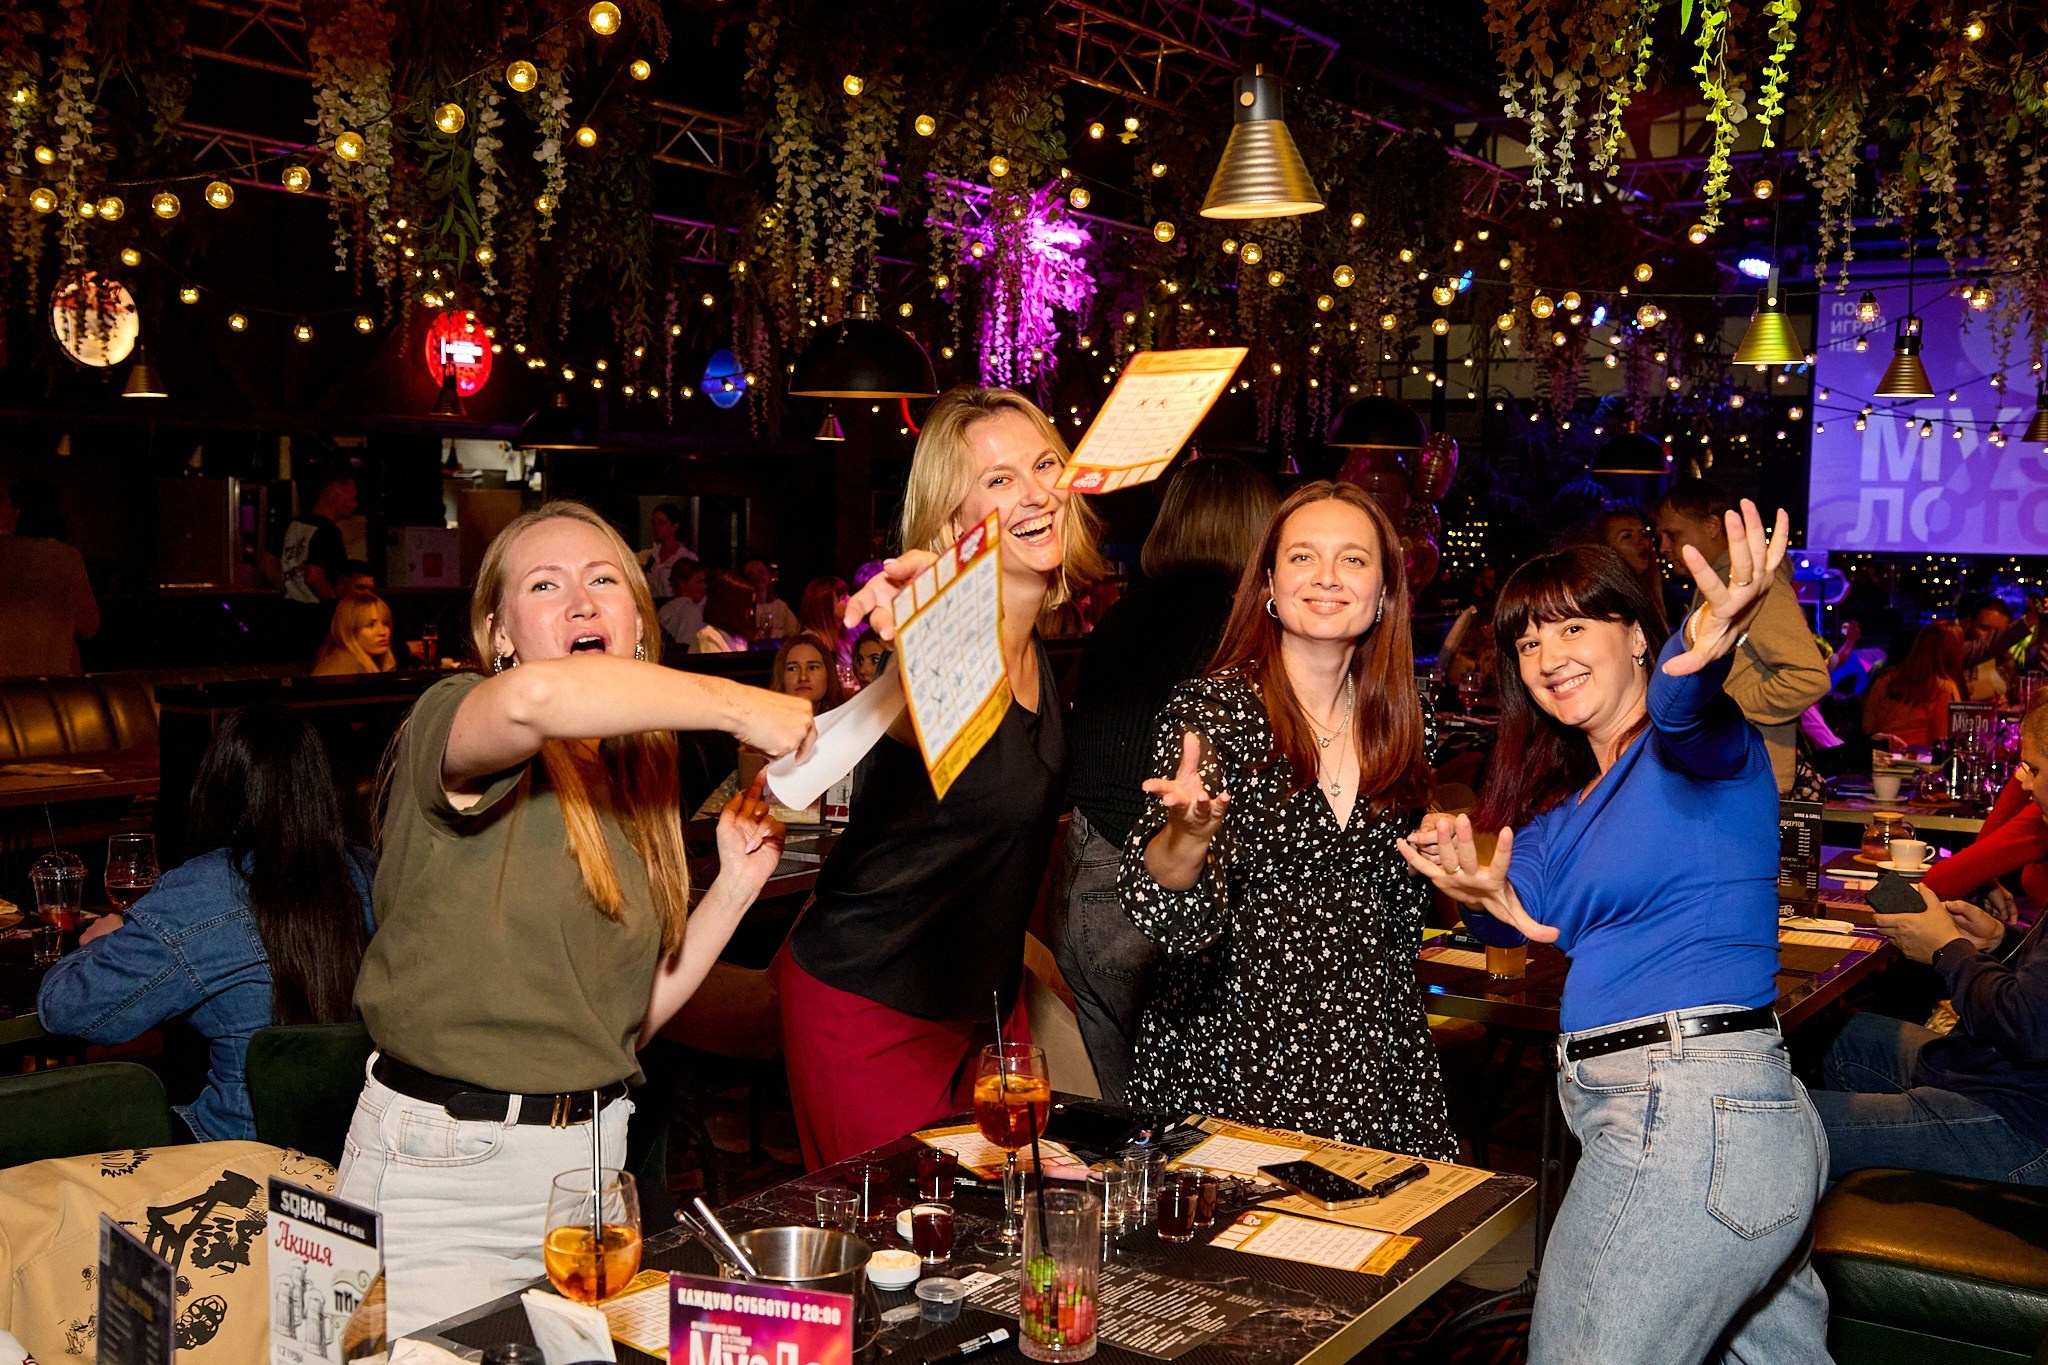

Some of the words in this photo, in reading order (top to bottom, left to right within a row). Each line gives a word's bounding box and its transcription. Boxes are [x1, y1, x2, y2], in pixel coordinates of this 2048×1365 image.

[275, 1221, 333, 1267] Акция
[677, 1287, 733, 1311] КАЖДУЮ
[733, 1294, 791, 1319] СУББОТУ
[791, 1301, 801, 1320] В
[802, 1303, 841, 1326] 20:00
